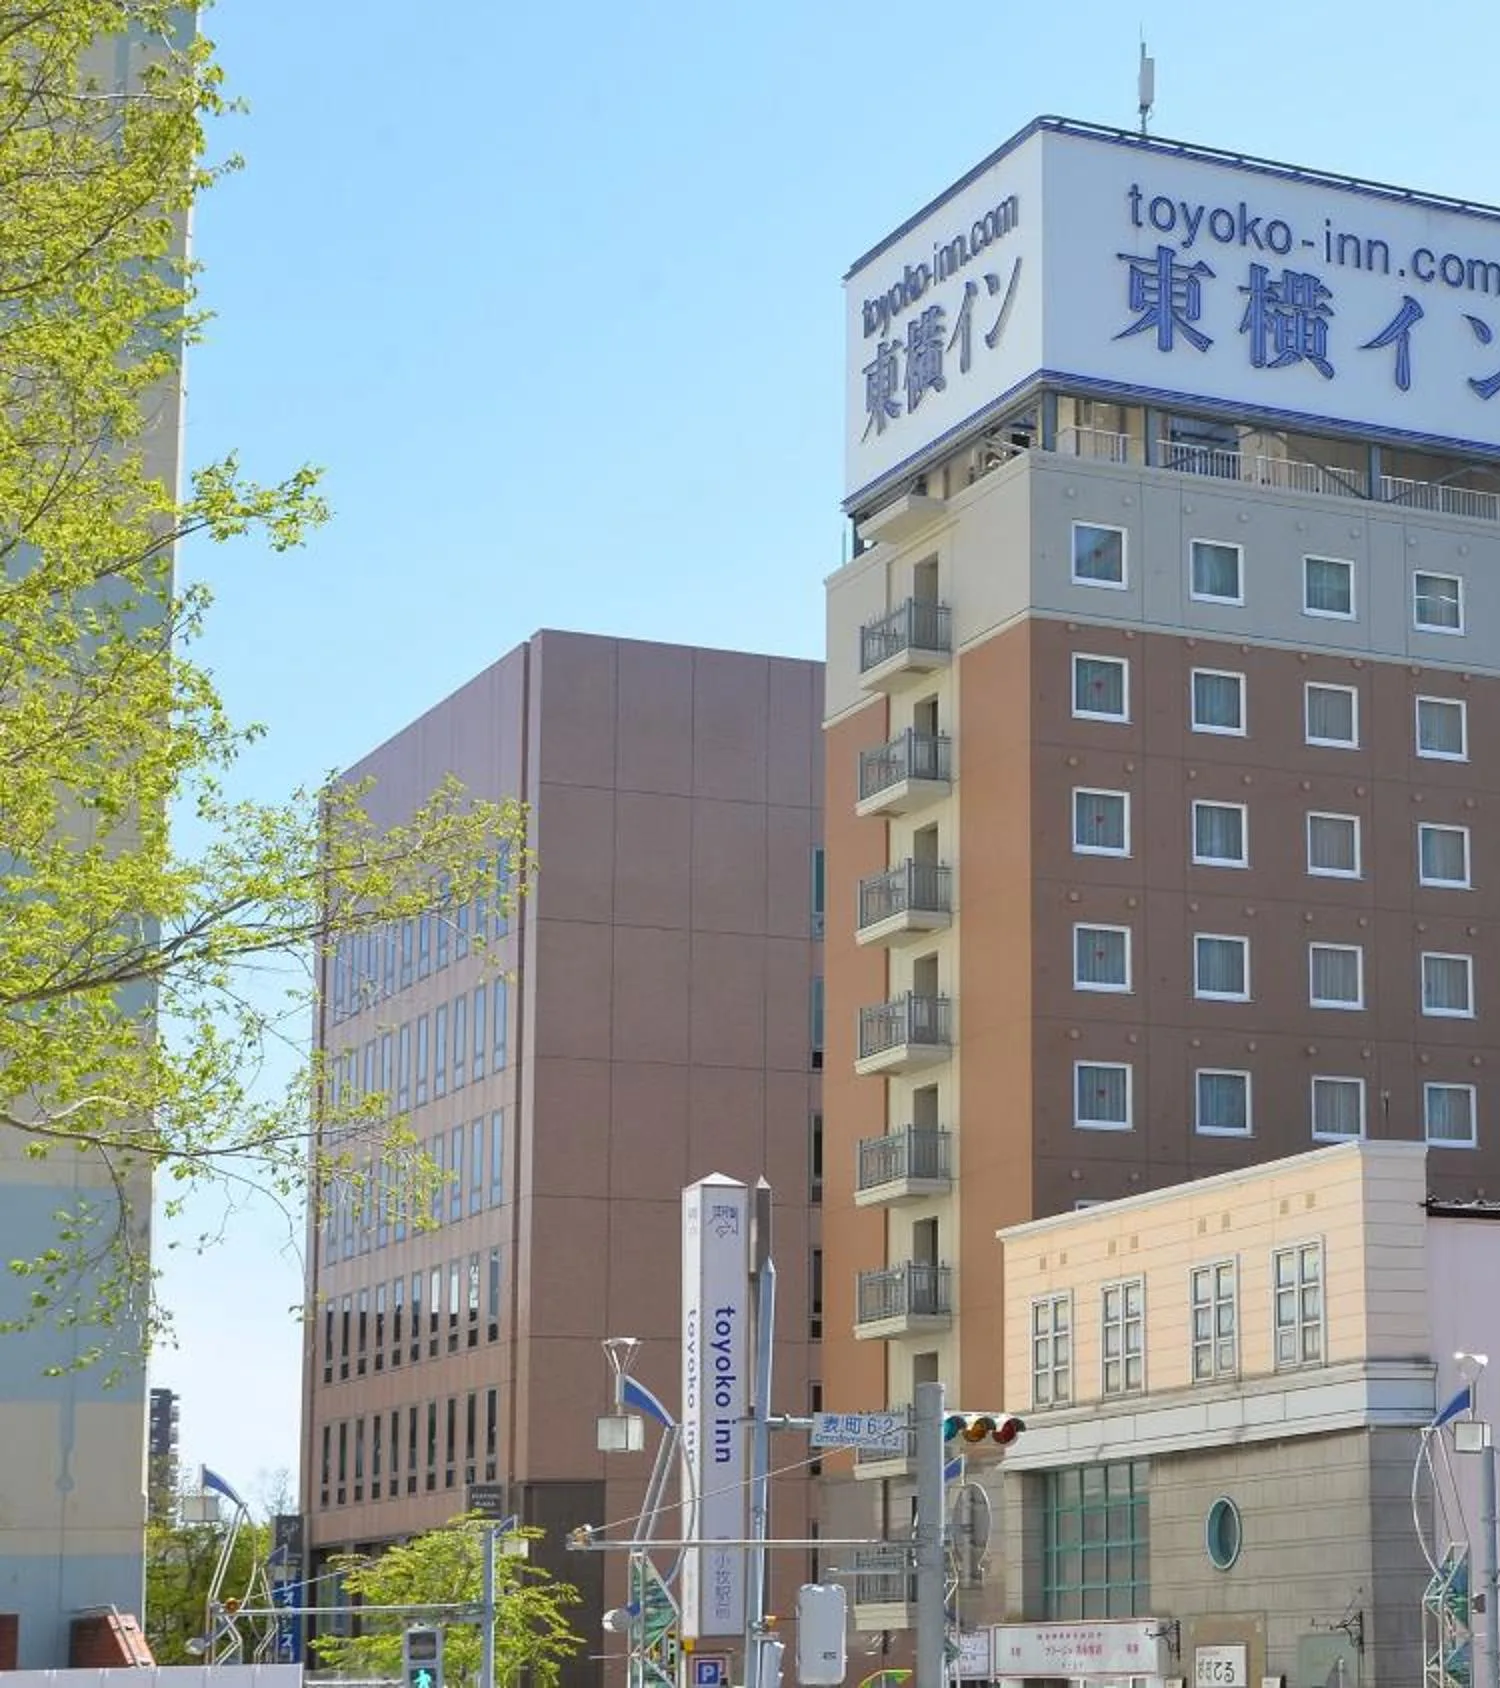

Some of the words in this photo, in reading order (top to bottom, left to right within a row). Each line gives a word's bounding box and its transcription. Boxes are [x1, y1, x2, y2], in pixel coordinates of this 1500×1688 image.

[862, 194, 1019, 338] toyoko-inn.com
[861, 256, 1023, 442] 東横イン
[687, 1309, 697, 1409] toyoko
[710, 1305, 736, 1408] toyoko
[715, 1419, 737, 1463] inn
[823, 1415, 862, 1435] 表町
